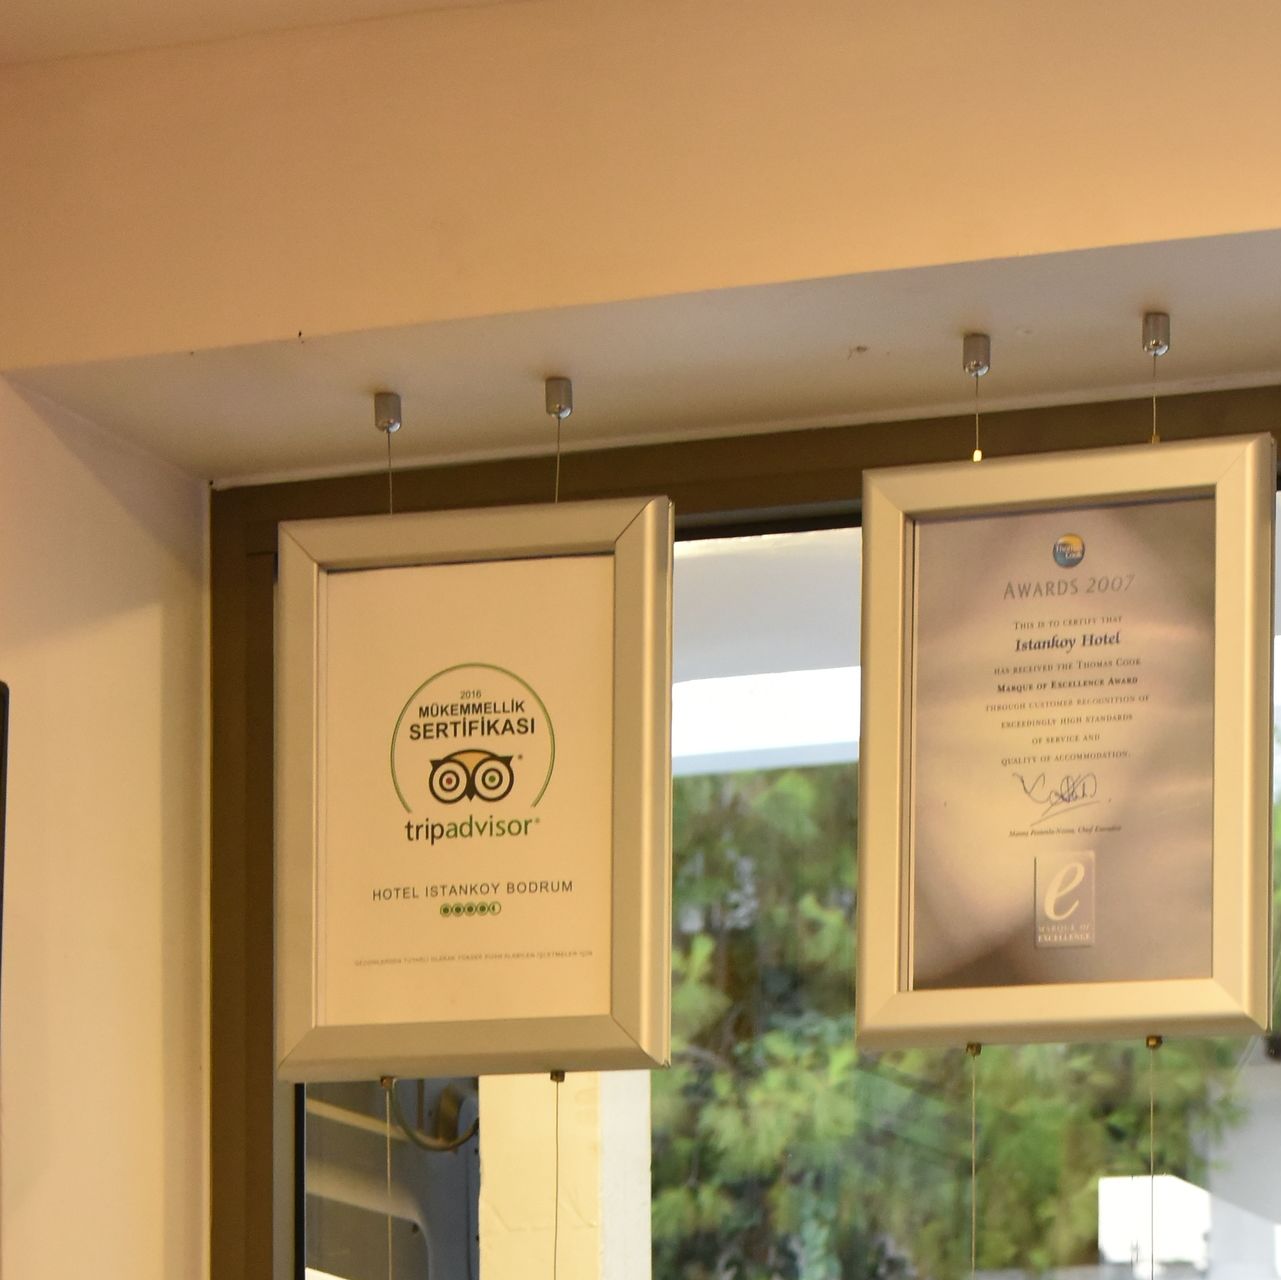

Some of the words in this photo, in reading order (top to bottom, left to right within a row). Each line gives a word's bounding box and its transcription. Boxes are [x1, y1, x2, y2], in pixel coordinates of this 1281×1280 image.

[1086, 574, 1136, 593] 2007
[1015, 635, 1076, 654] Istankoy
[1082, 631, 1120, 647] Hotel
[460, 690, 481, 699] 2016
[418, 699, 525, 718] MÜKEMMELLİK
[409, 717, 536, 741] SERTİFİKASI
[372, 887, 419, 901] HOTEL
[426, 883, 500, 898] ISTANKOY
[507, 881, 573, 894] BODRUM
